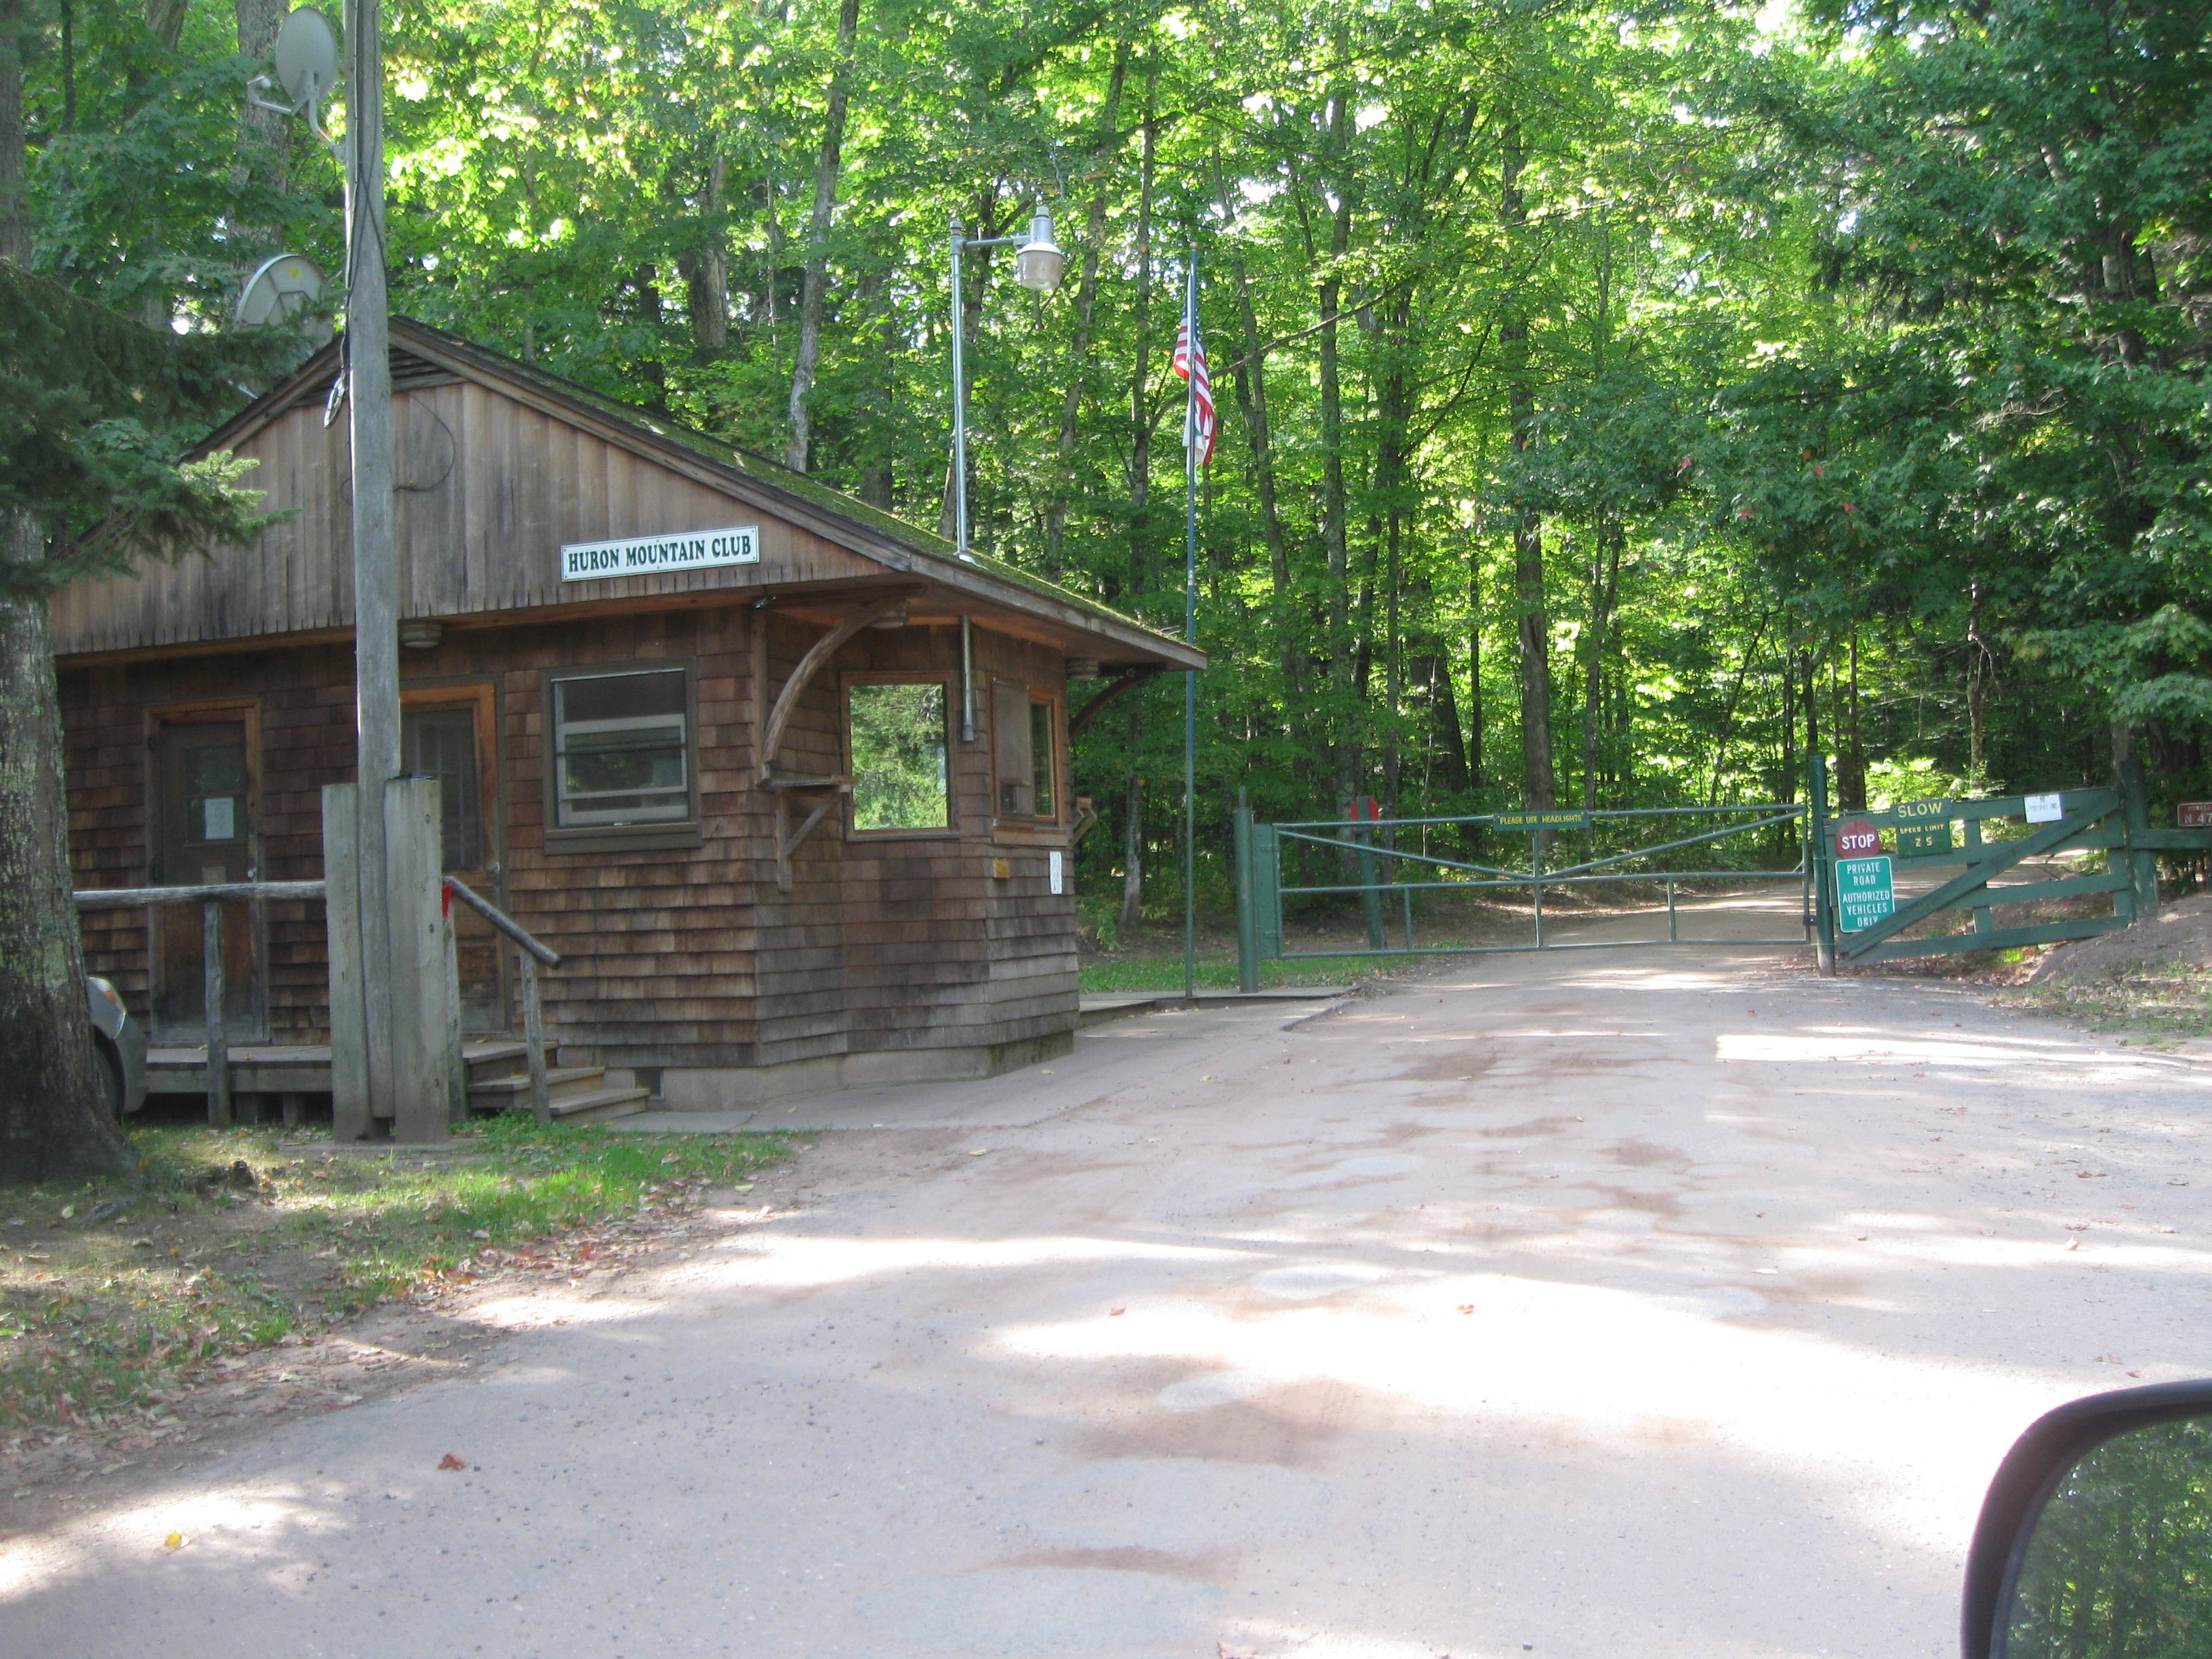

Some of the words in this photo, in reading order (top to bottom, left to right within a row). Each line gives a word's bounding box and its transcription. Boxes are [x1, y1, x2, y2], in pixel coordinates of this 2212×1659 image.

[568, 548, 619, 573] HURON
[626, 539, 705, 567] MOUNTAIN
[712, 535, 751, 558] CLUB
[1898, 802, 1942, 818] SLOW
[1499, 816, 1523, 825] PLEASE
[1525, 815, 1538, 824] USE
[1542, 814, 1582, 823] HEADLIGHTS
[1900, 825, 1921, 834] SPEED
[1925, 823, 1944, 832] LIMIT
[1841, 834, 1875, 850] STOP
[1847, 862, 1881, 875] PRIVATE
[1853, 875, 1876, 886] ROAD
[1843, 890, 1890, 903] AUTHORIZED
[1846, 903, 1887, 916] VEHICLES
[1857, 915, 1878, 928] ONLY
